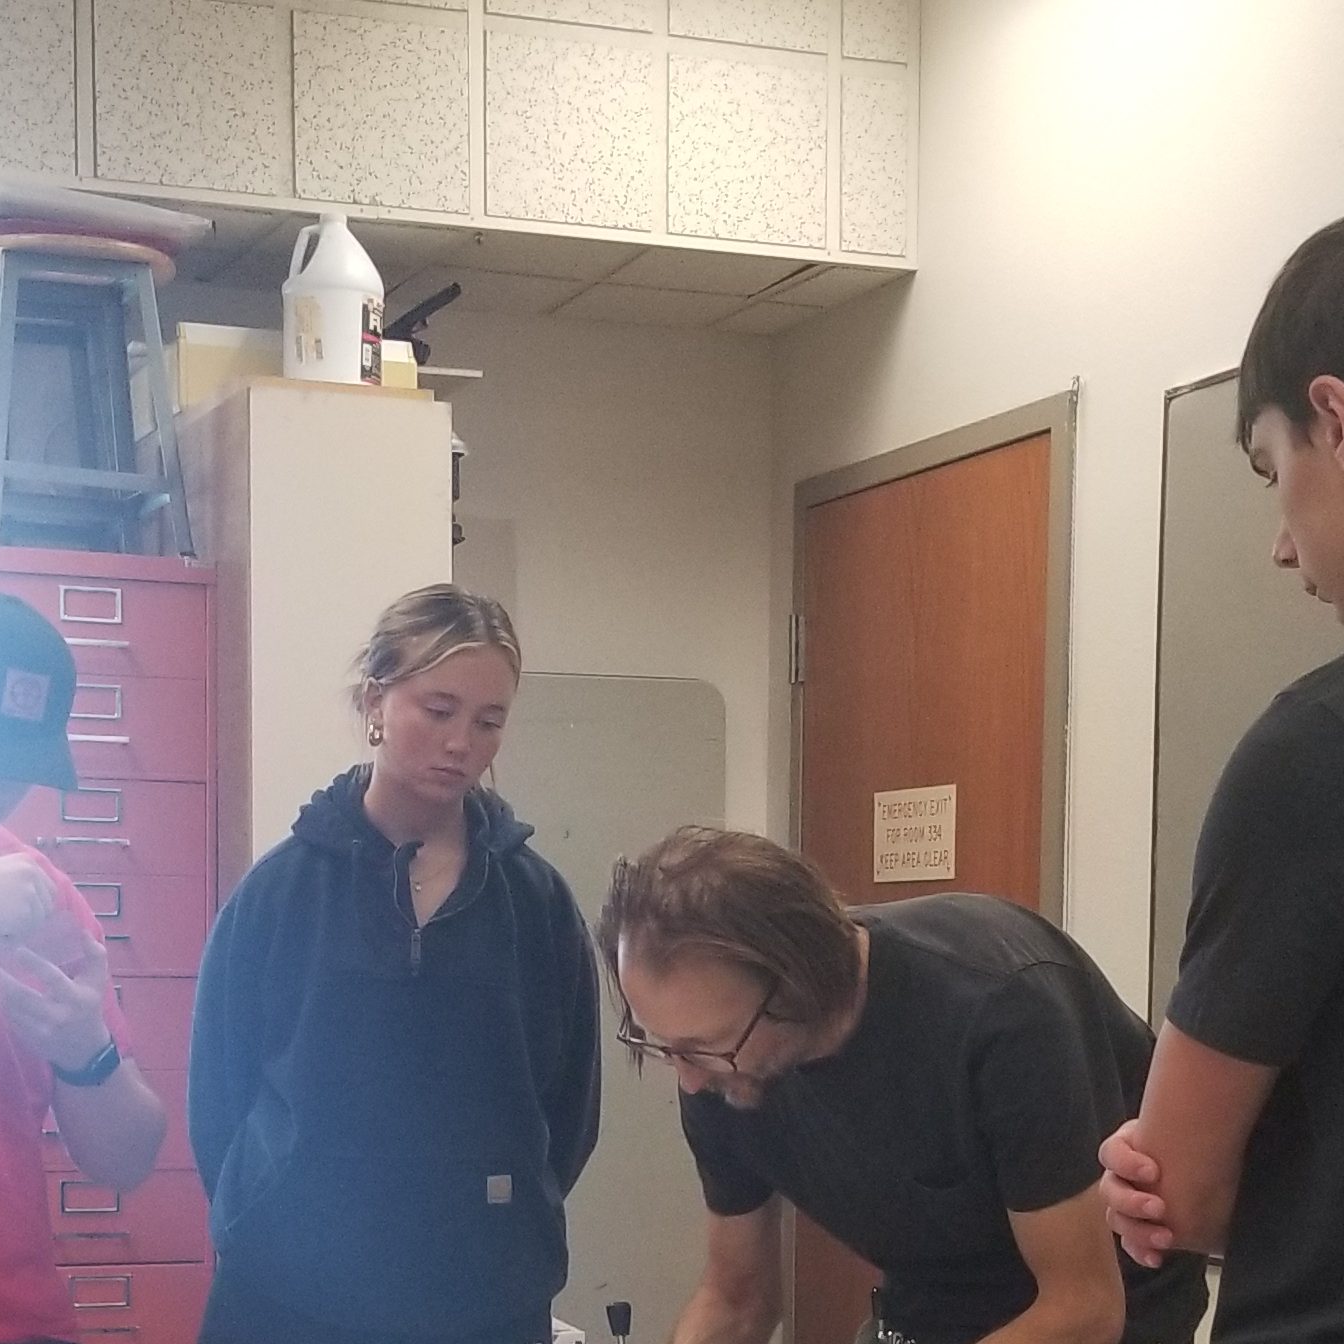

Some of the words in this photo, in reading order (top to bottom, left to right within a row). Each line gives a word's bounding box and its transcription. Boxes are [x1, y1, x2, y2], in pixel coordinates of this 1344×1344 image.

[930, 798, 947, 816] EXIT
[886, 827, 900, 844] FOR
[903, 826, 924, 843] ROOM
[880, 852, 899, 870] KEEP
[902, 851, 920, 868] AREA
[924, 849, 949, 867] CLEAR
